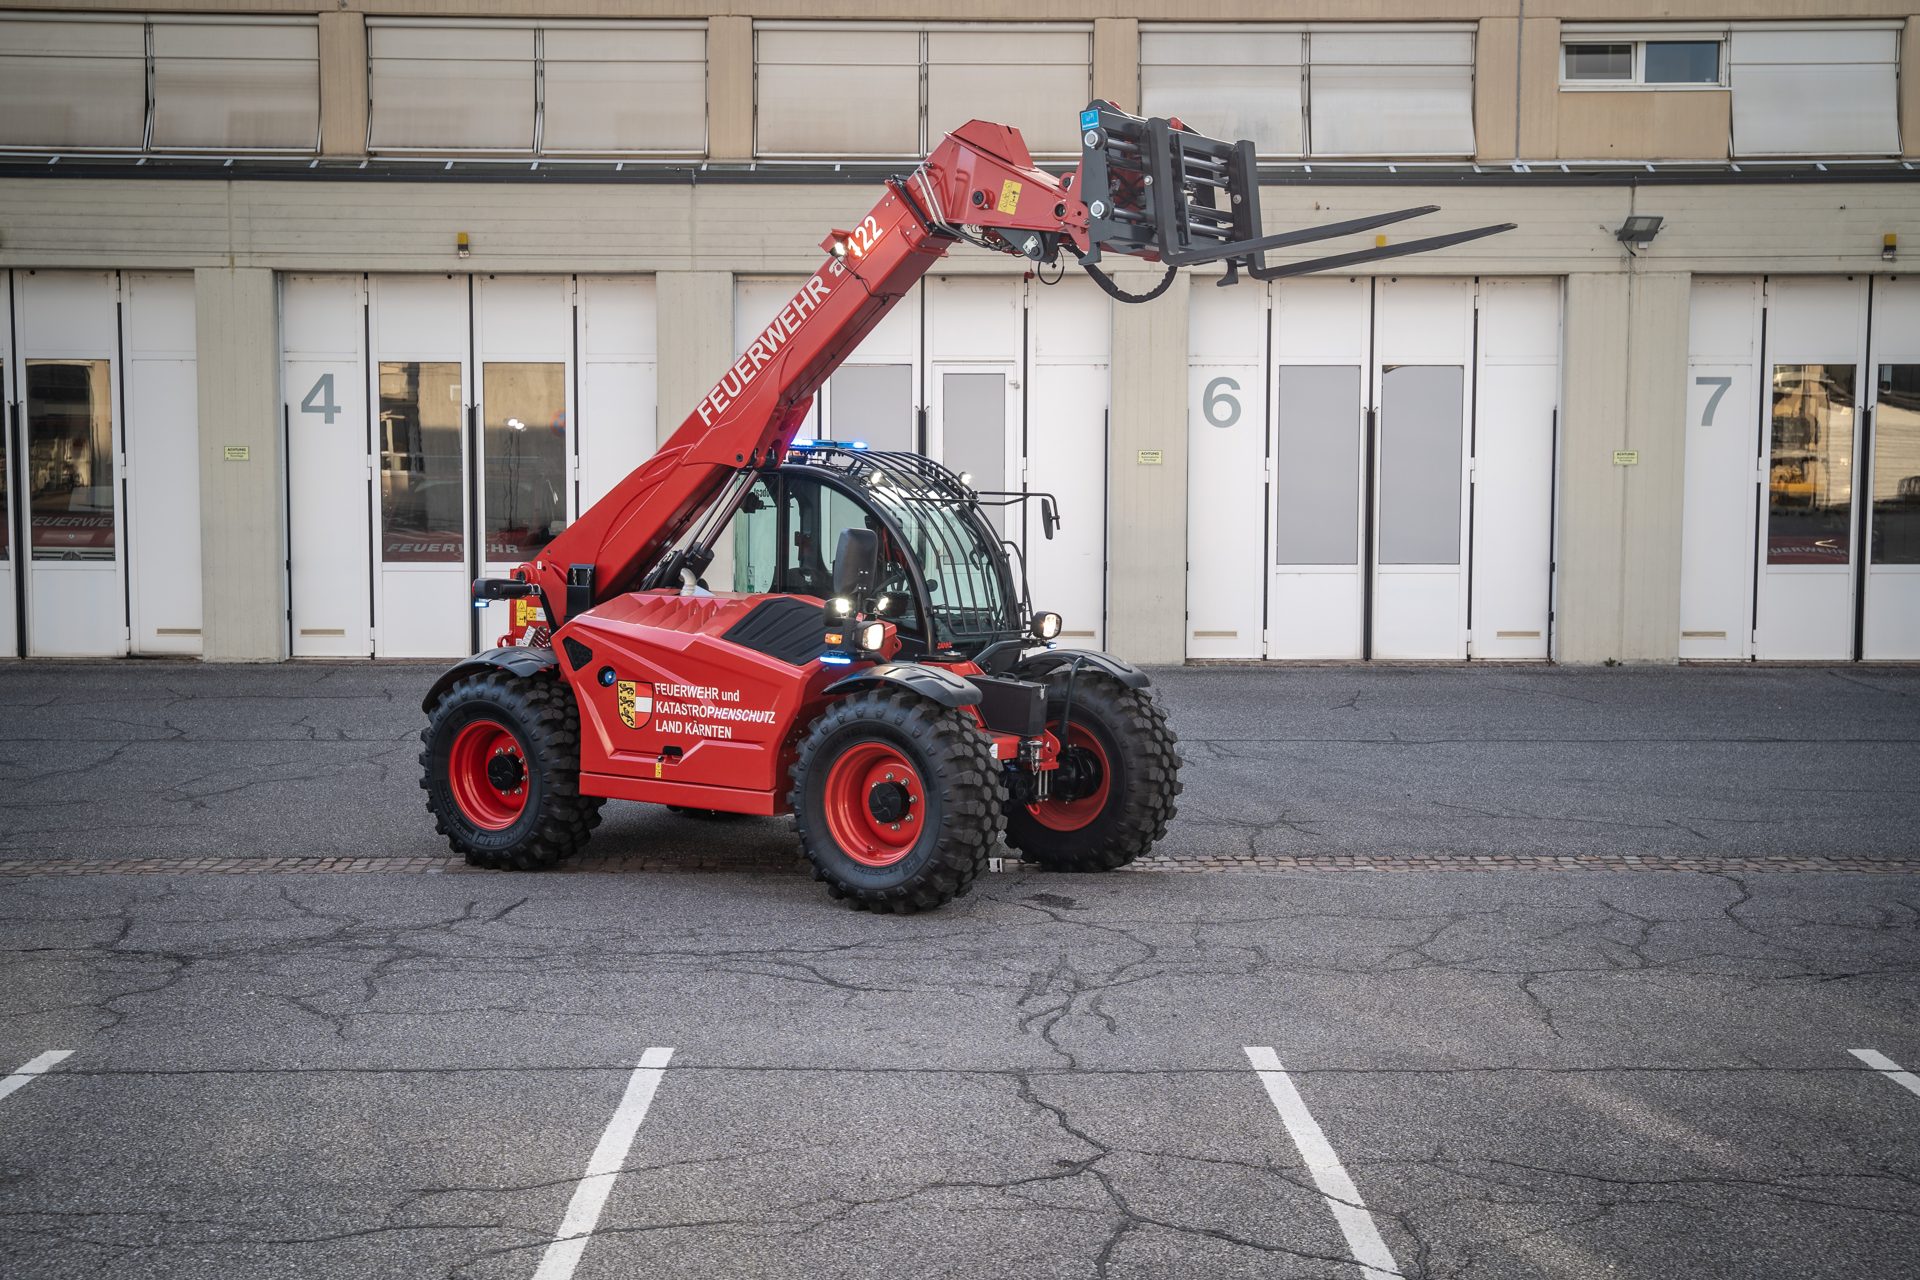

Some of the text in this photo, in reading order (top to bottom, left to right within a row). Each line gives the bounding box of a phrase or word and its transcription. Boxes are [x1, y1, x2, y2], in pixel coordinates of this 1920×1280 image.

[697, 215, 884, 427] FEUERWEHR 122
[301, 374, 342, 424] 4
[1203, 376, 1241, 428] 6
[1696, 376, 1732, 426] 7
[31, 516, 114, 527] EUERWE
[655, 683, 740, 702] FEUERWEHR und
[655, 701, 776, 724] KATASTROPHENSCHUTZ
[655, 720, 732, 739] LAND KÄRNTEN
